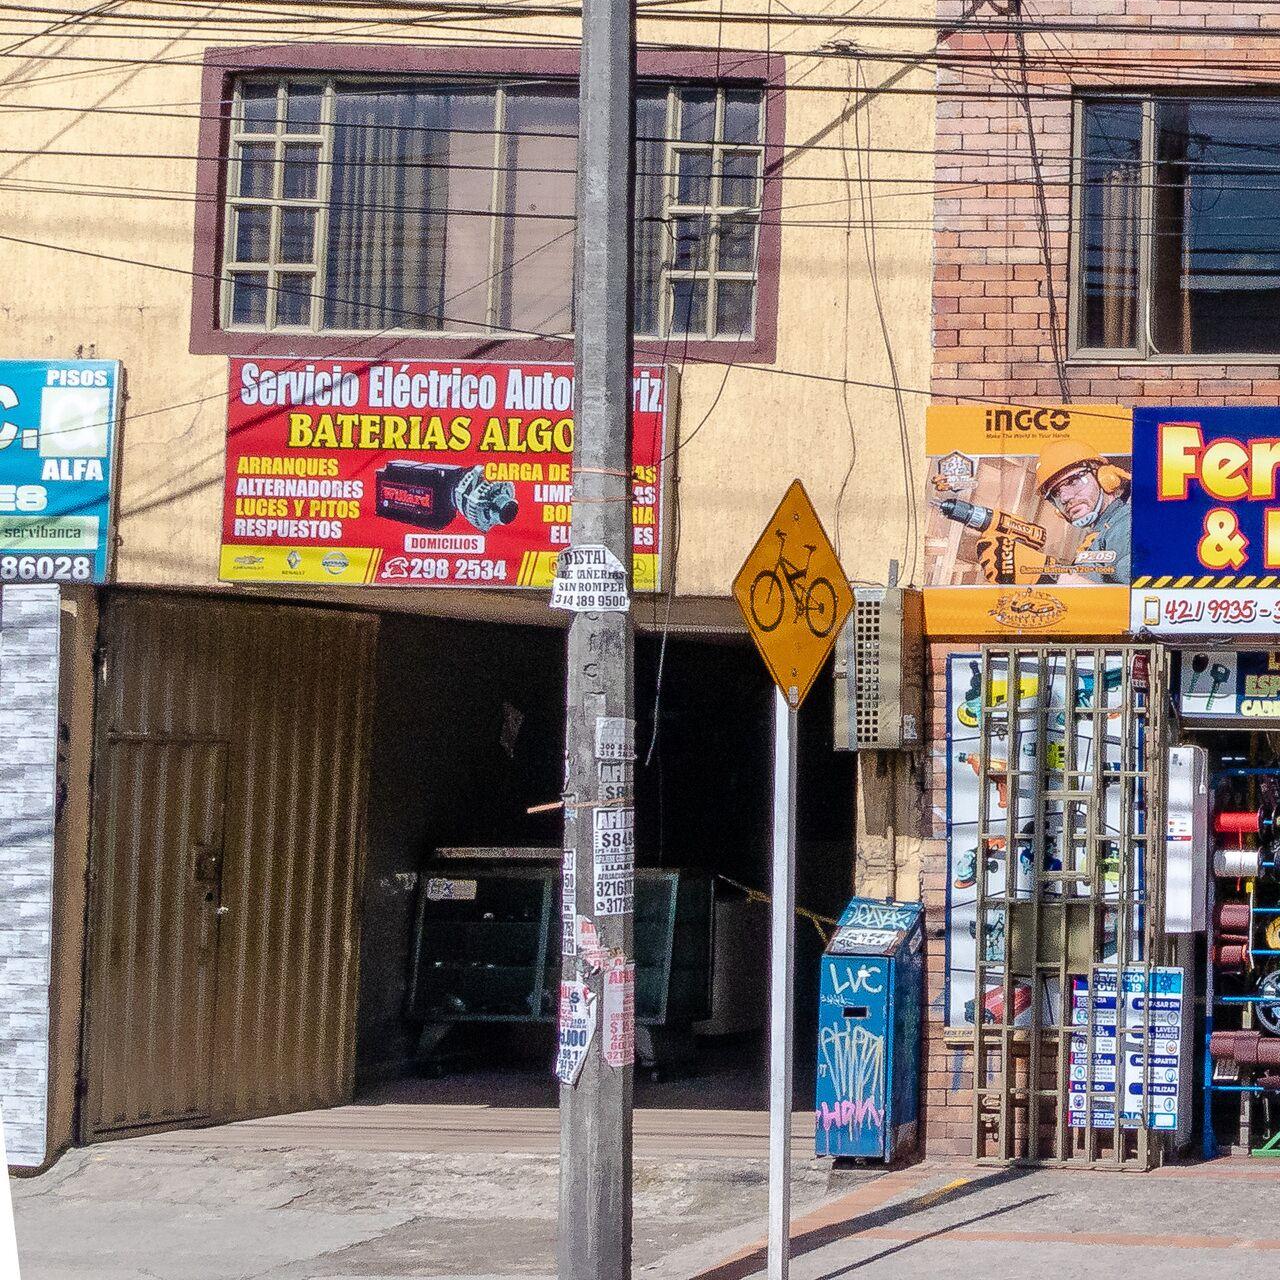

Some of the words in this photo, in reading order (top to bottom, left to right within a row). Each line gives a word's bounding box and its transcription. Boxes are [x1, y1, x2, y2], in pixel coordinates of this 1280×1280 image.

[46, 369, 108, 387] PISOS
[241, 362, 360, 408] Servicio
[368, 364, 497, 410] Eléctrico
[504, 368, 663, 413] Autoriz
[288, 413, 473, 451] BATERIAS
[42, 459, 103, 481] ALFA
[237, 456, 339, 477] ARRANQUES
[485, 462, 544, 481] CARGA
[548, 463, 570, 481] DE
[235, 478, 364, 499] ALTERNADORES
[235, 498, 288, 517] LUCES
[294, 499, 308, 517] Y
[309, 499, 361, 519] PITOS
[4, 524, 81, 539] servibanca
[234, 519, 342, 539] RESPUESTOS
[1197, 506, 1250, 570] &
[411, 536, 478, 551] DOMICILIOS
[410, 557, 448, 580] 298
[454, 559, 507, 581] 2534
[559, 582, 576, 593] SIN
[578, 582, 625, 593] ROMPER
[597, 595, 626, 607] 9500
[1165, 599, 1204, 624] 421
[1207, 599, 1257, 623] 9935
